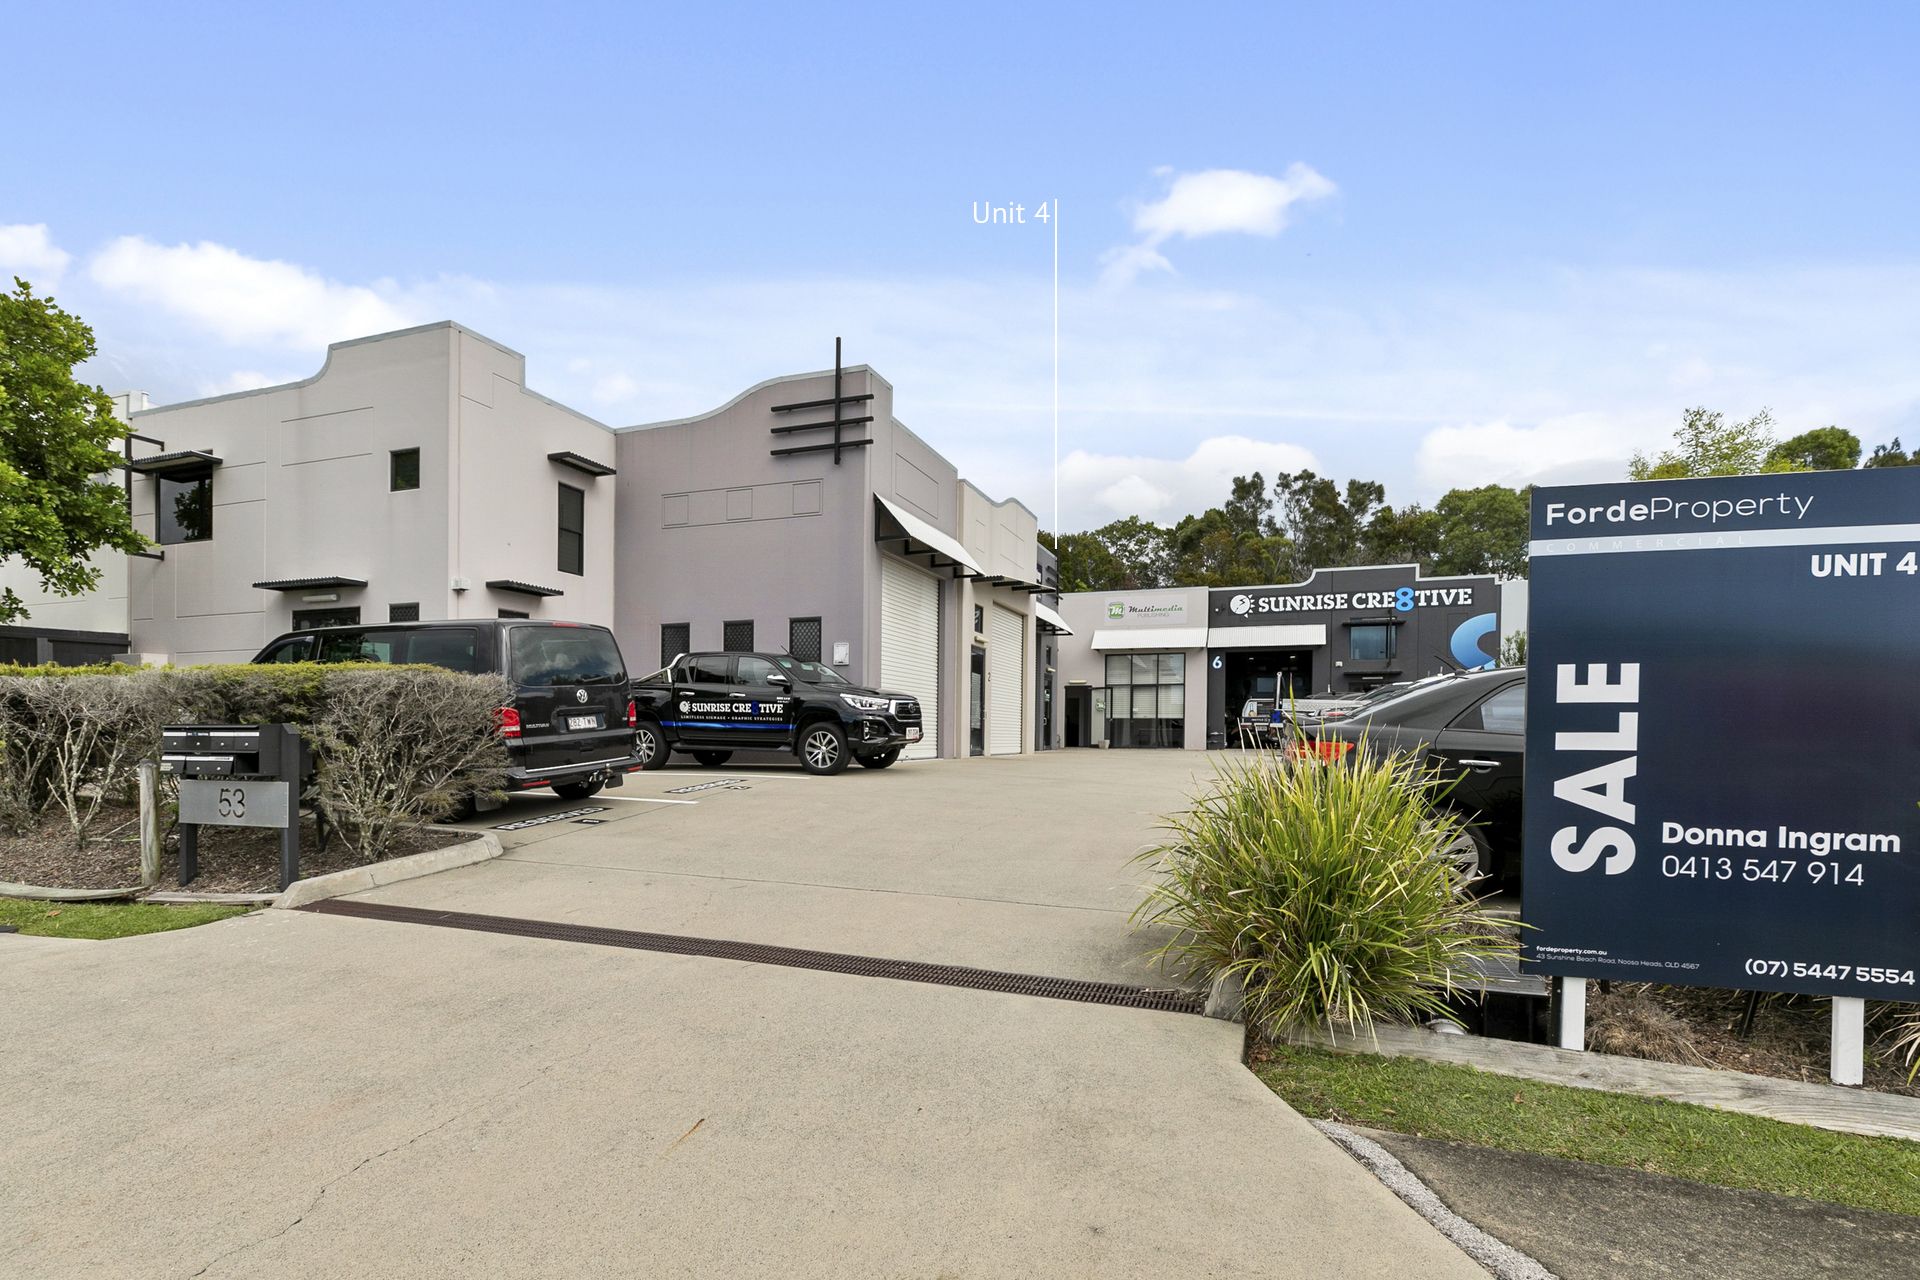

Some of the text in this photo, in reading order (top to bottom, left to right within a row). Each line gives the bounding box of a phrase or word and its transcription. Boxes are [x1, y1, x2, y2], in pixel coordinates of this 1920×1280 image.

[1546, 492, 1814, 526] FordeProperty
[1546, 535, 1745, 553] COMMERCIAL
[1811, 551, 1918, 578] UNIT 4
[1128, 604, 1184, 613] Multimedia
[1258, 587, 1472, 613] SUNRISE CRE8TIVE
[1212, 655, 1223, 669] 6
[691, 701, 784, 715] SUNRISE CRE8TIVE
[1550, 662, 1640, 876] SALE
[219, 787, 245, 819] 53
[1662, 822, 1901, 857] Donna Ingram
[1662, 855, 1864, 886] 0413 547 914
[1536, 945, 1608, 956] fordeproperty.com.au
[1547, 953, 1575, 961] Sunshine
[1680, 962, 1700, 970] 4567
[1745, 958, 1916, 985] (07) 5447 5554
